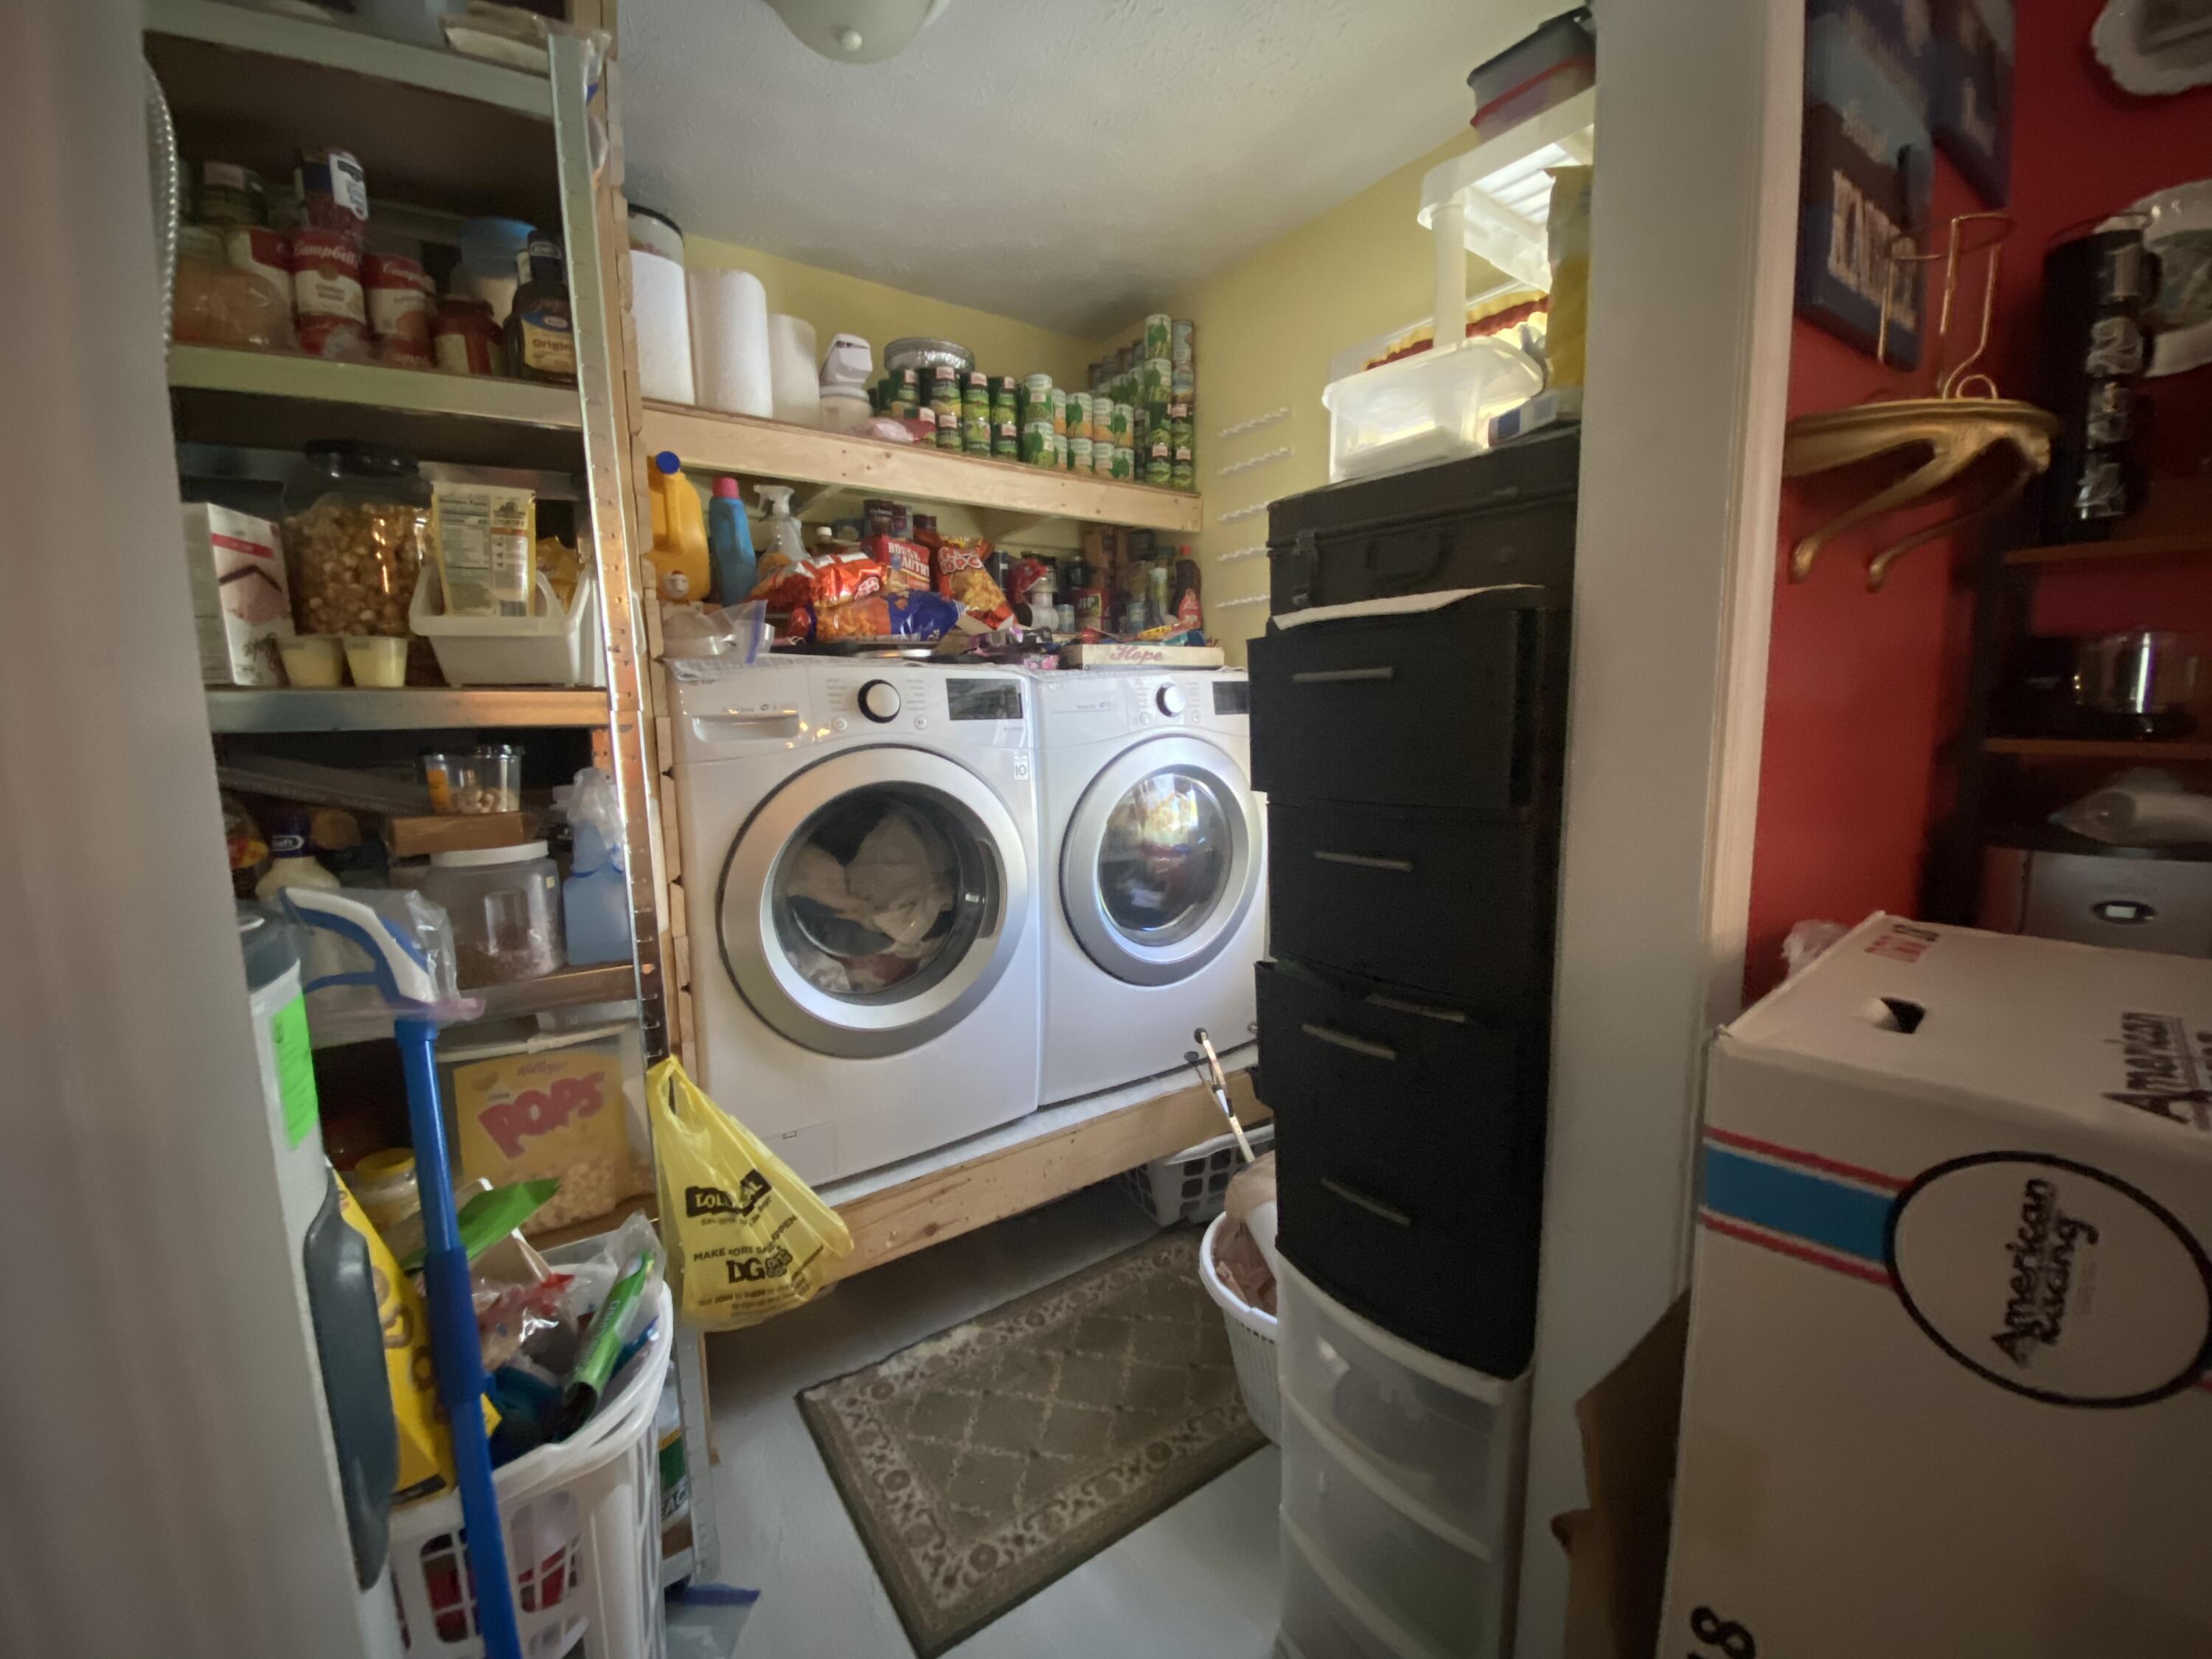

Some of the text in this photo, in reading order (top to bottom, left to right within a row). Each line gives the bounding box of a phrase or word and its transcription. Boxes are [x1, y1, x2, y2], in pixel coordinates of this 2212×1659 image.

[532, 338, 574, 354] Origin
[1110, 645, 1164, 664] Hope
[478, 1071, 605, 1160] POPS
[771, 1214, 797, 1242] APPEN
[694, 1248, 726, 1262] MAKE
[726, 1257, 765, 1284] DG
[1991, 1179, 2056, 1367] American
